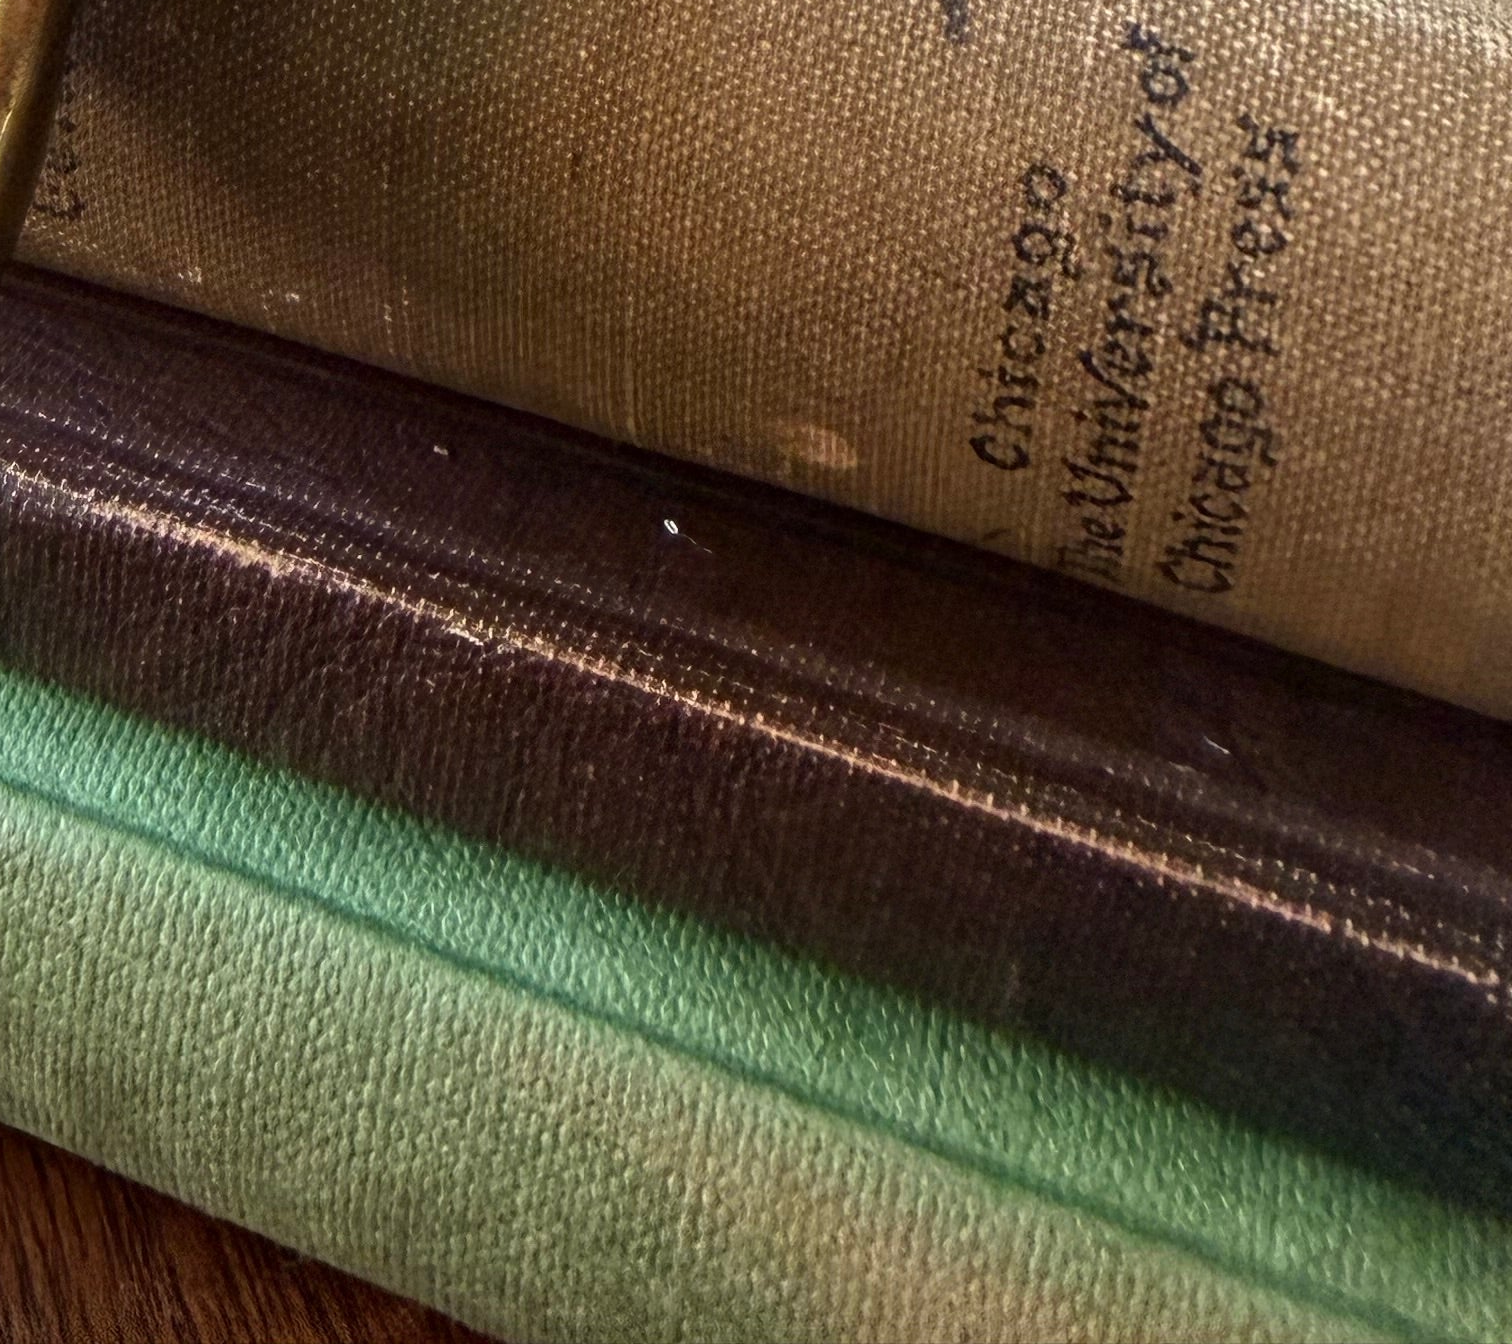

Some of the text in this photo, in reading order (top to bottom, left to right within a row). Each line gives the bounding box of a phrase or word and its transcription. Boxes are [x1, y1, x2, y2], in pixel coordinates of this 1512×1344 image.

[1124, 20, 1196, 105] of
[970, 162, 1081, 471] Chicago
[1061, 114, 1204, 509] University
[1157, 112, 1302, 595] Chicago Press
